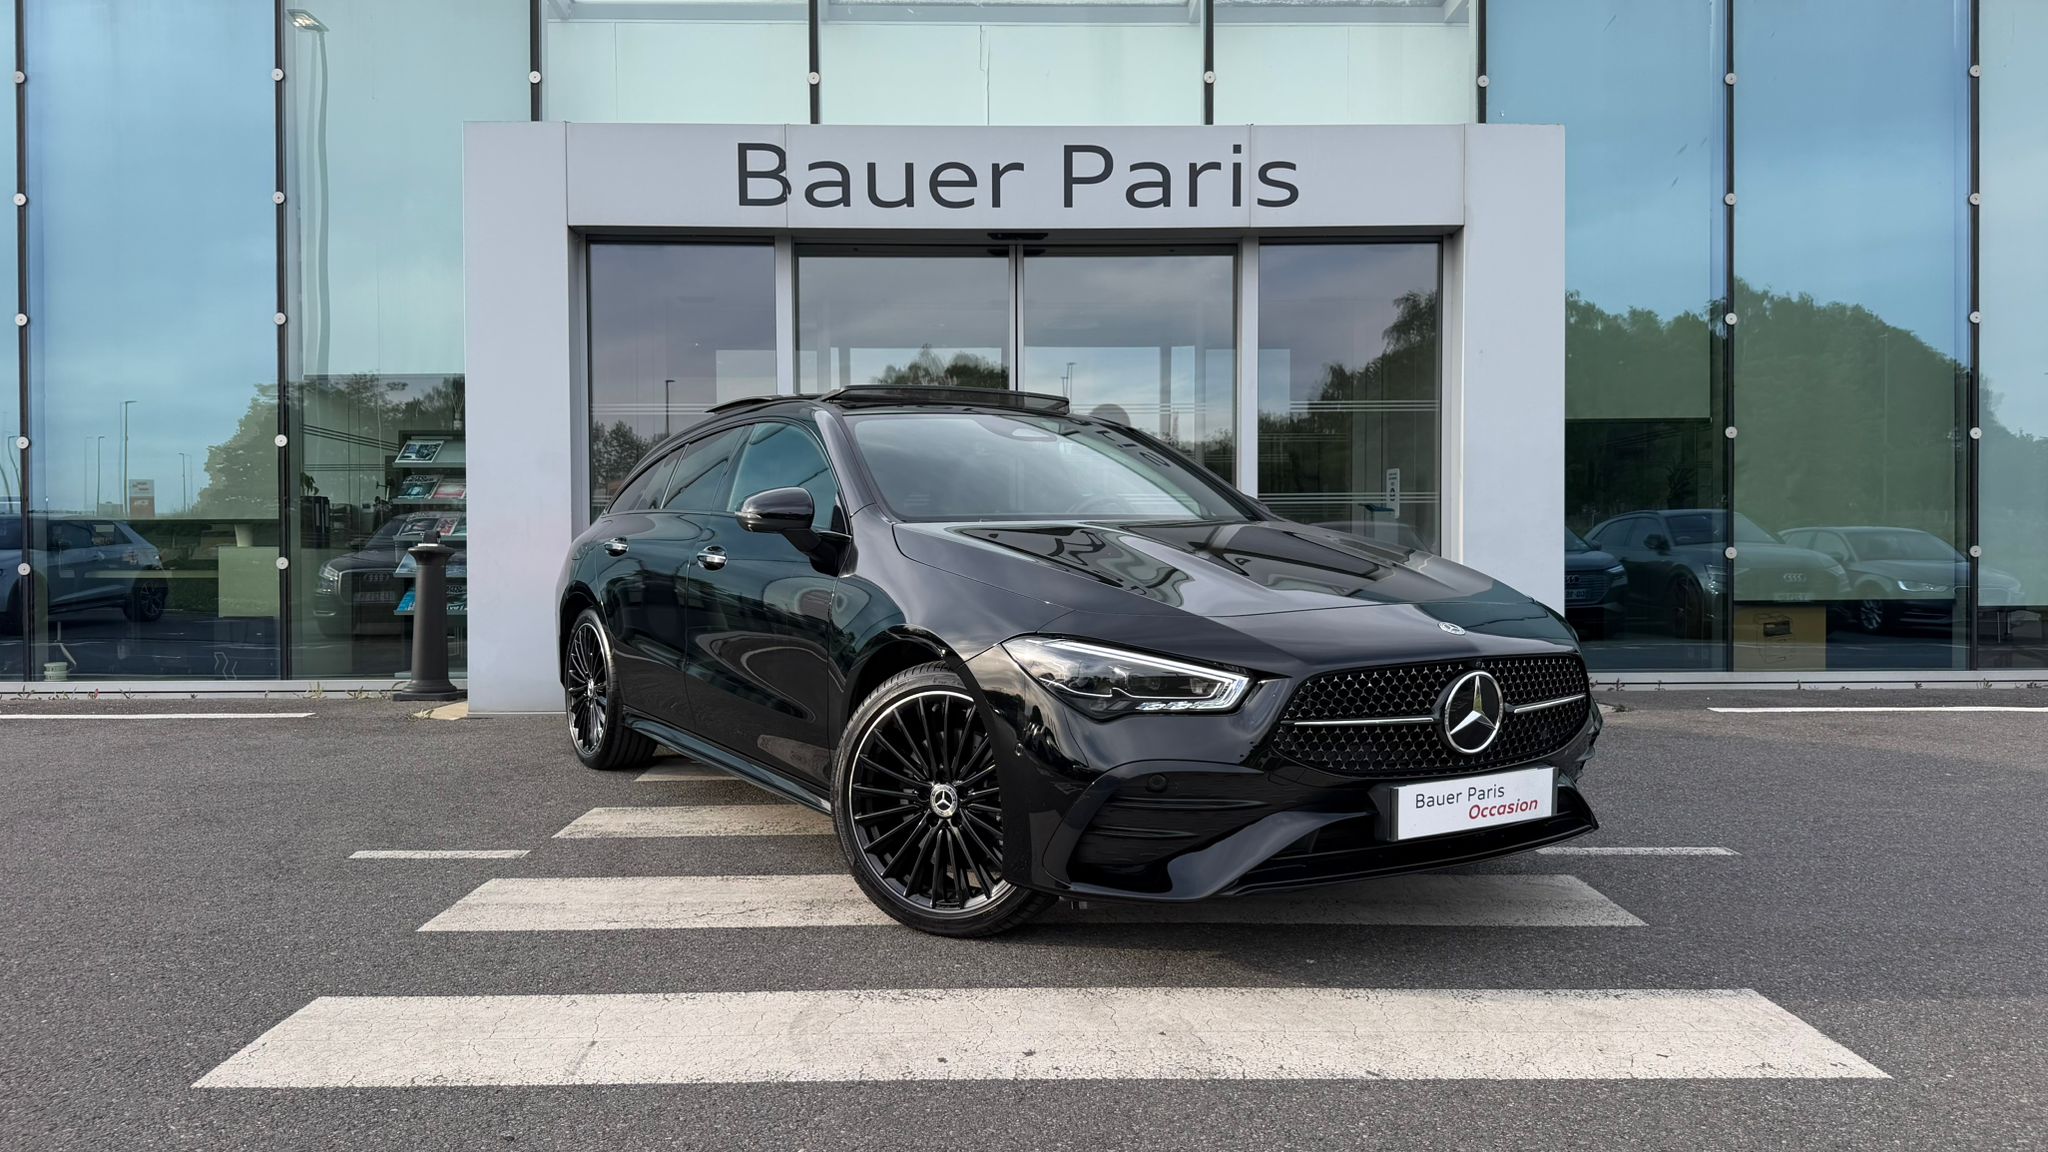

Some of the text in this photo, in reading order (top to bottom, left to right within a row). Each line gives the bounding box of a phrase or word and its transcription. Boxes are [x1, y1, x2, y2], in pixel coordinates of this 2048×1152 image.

[737, 142, 1300, 209] Bauer Paris
[1415, 784, 1505, 809] Bauer Paris
[1468, 798, 1539, 820] Occasion
